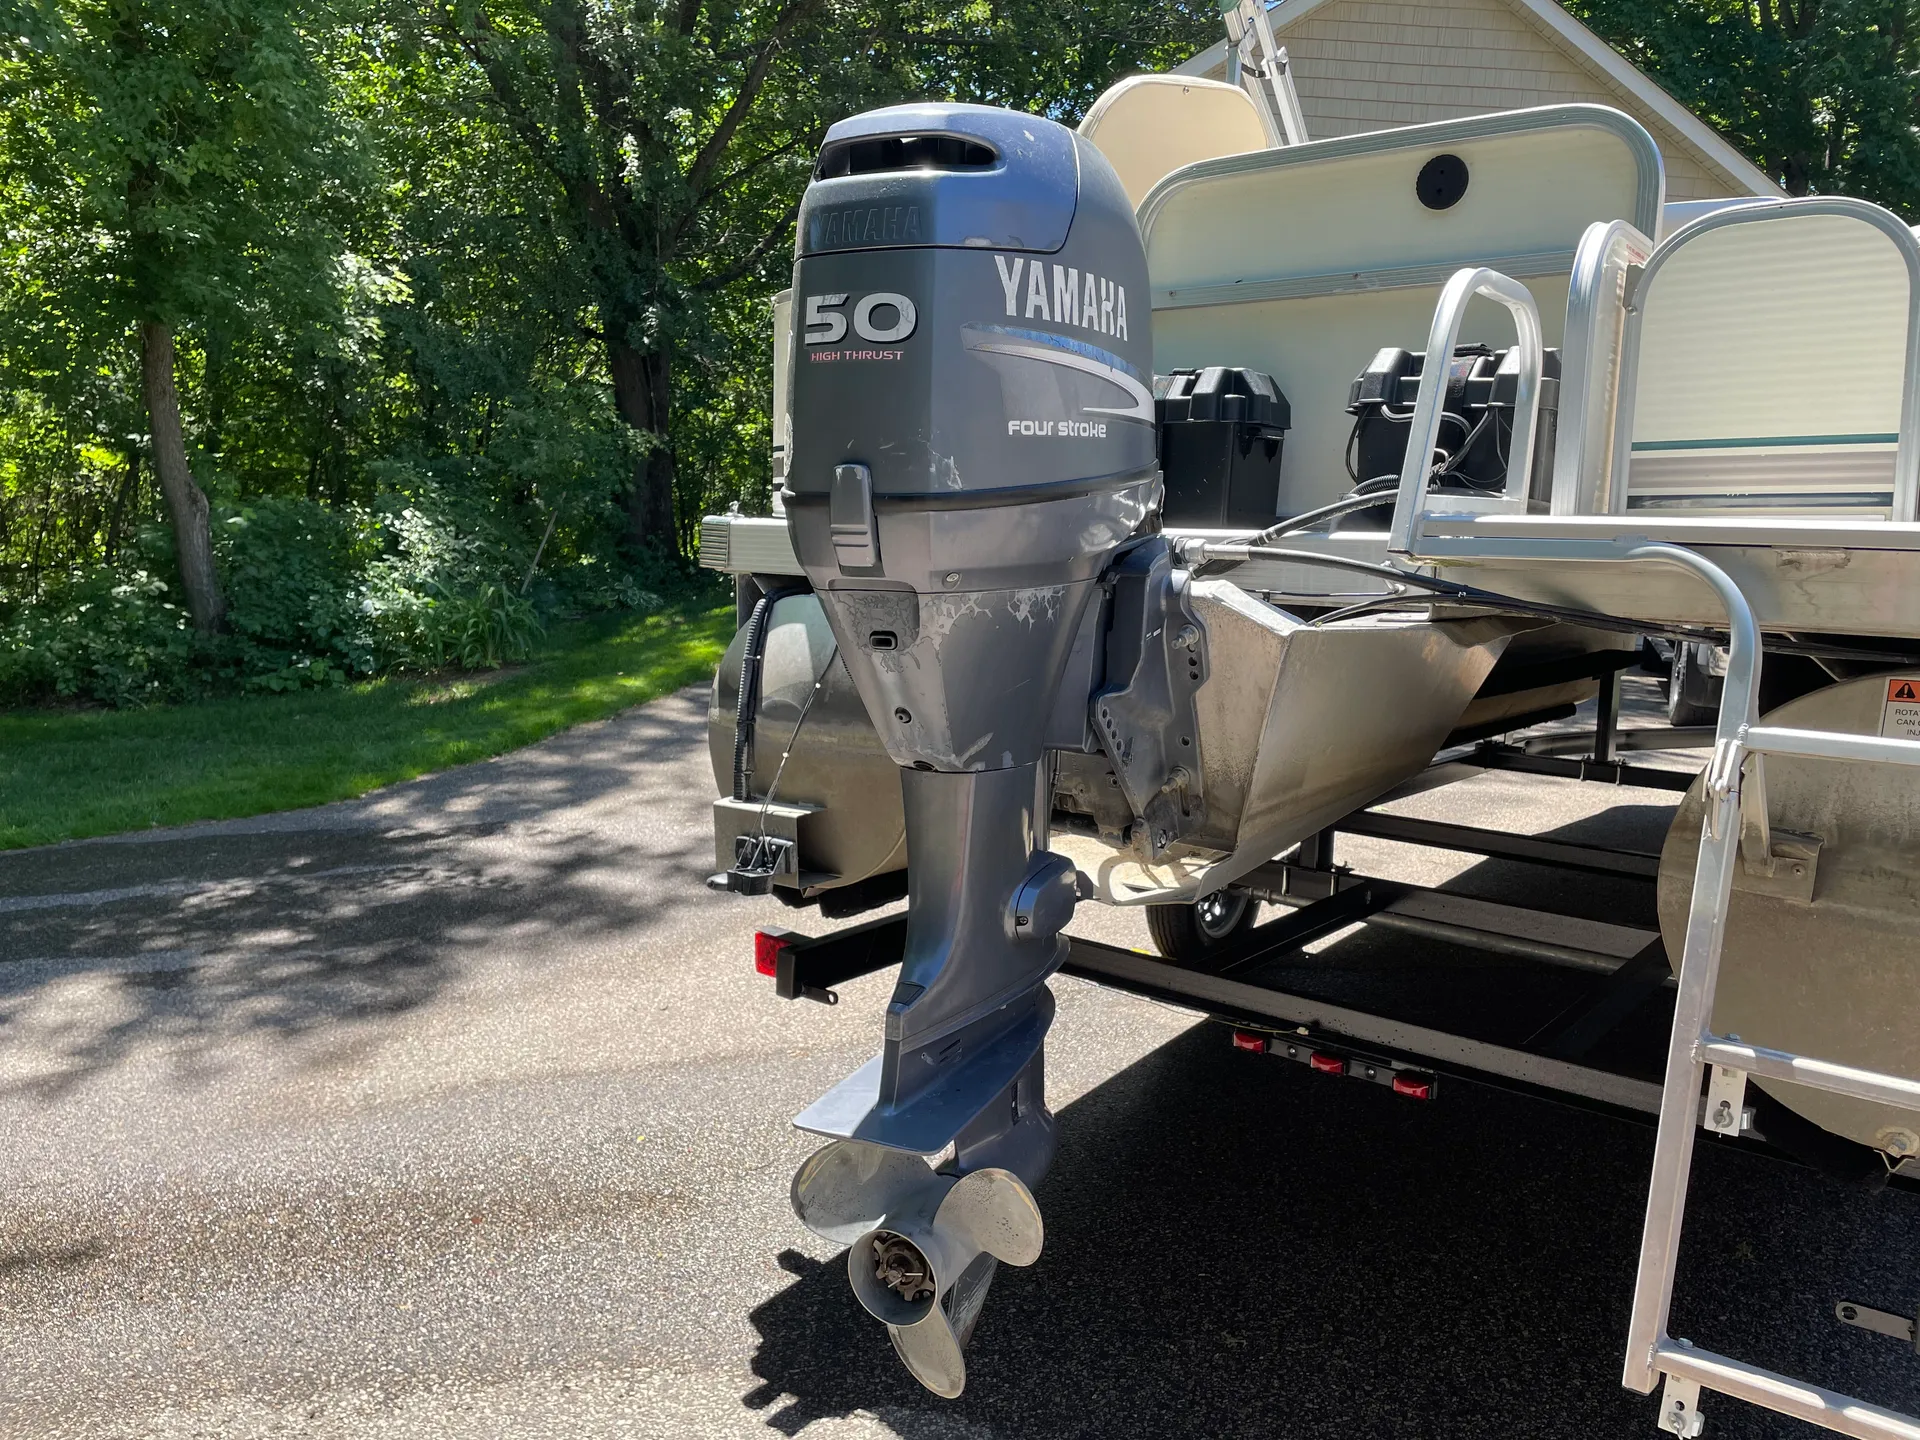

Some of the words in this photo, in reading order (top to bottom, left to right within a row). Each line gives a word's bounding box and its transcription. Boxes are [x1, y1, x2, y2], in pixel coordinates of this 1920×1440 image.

[811, 206, 922, 246] YAMAHA
[994, 255, 1128, 342] YAMAHA
[804, 293, 917, 345] 50
[811, 351, 840, 362] HIGH
[843, 350, 904, 361] THRUST
[1895, 708, 1920, 717] ROTA
[1896, 718, 1916, 726] CAN
